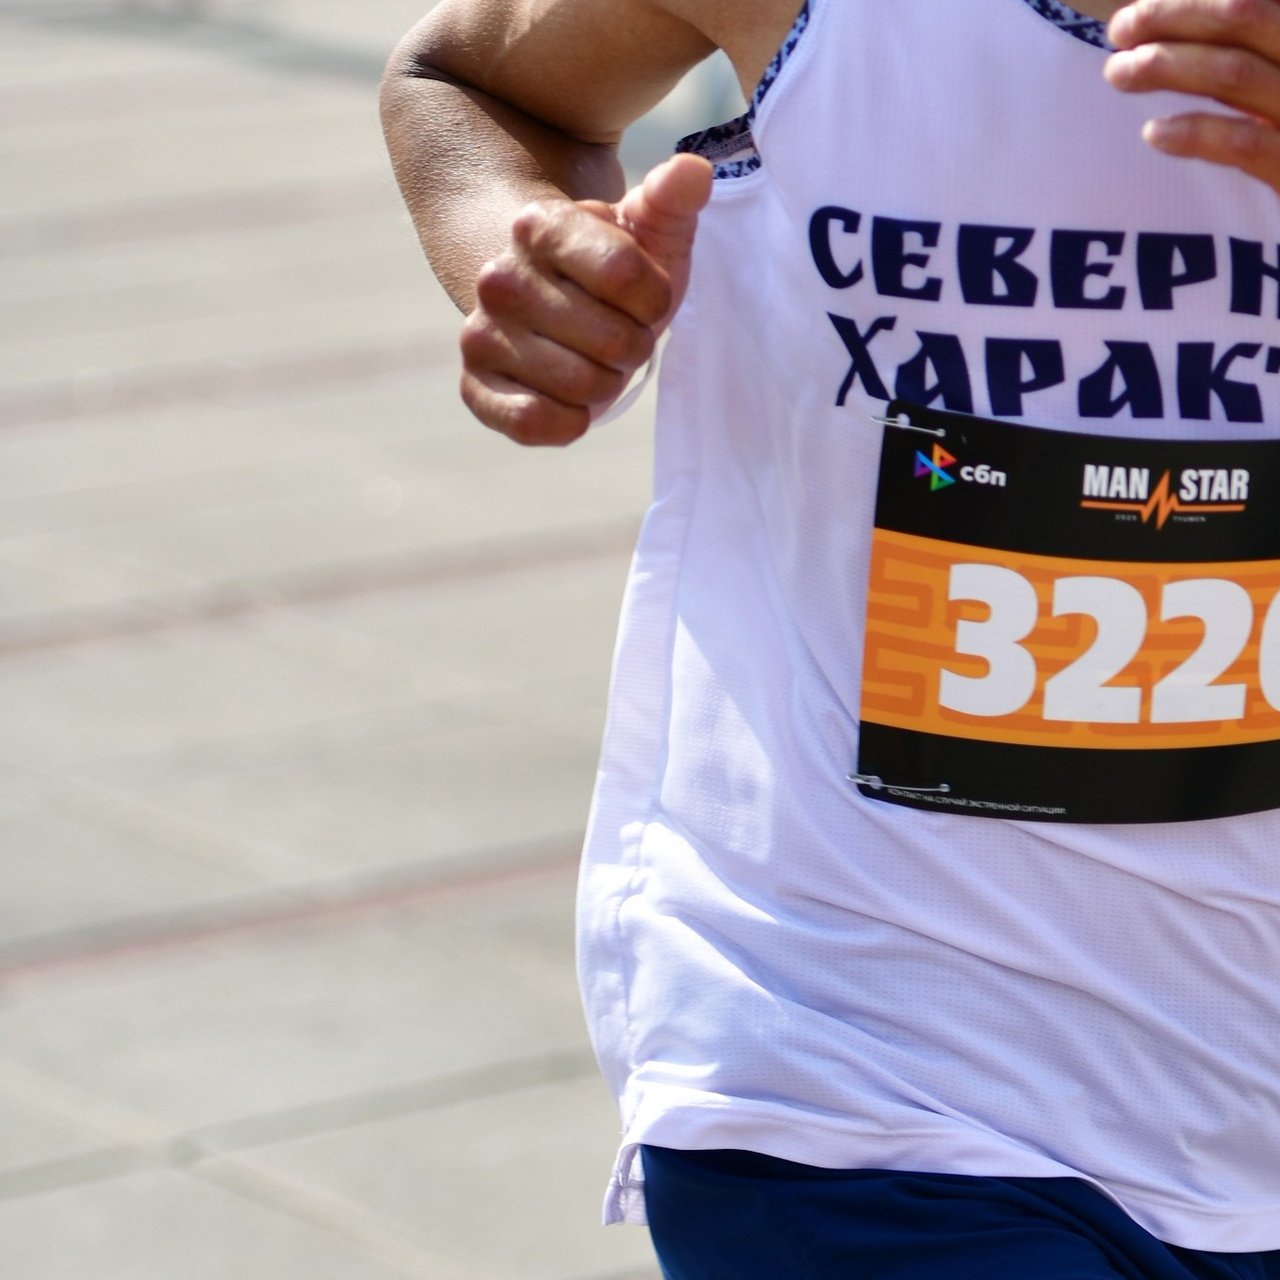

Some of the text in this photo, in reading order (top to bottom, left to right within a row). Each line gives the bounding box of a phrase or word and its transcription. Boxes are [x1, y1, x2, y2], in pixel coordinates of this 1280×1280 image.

[960, 464, 1007, 487] сбп
[1082, 464, 1250, 501] MAN STAR
